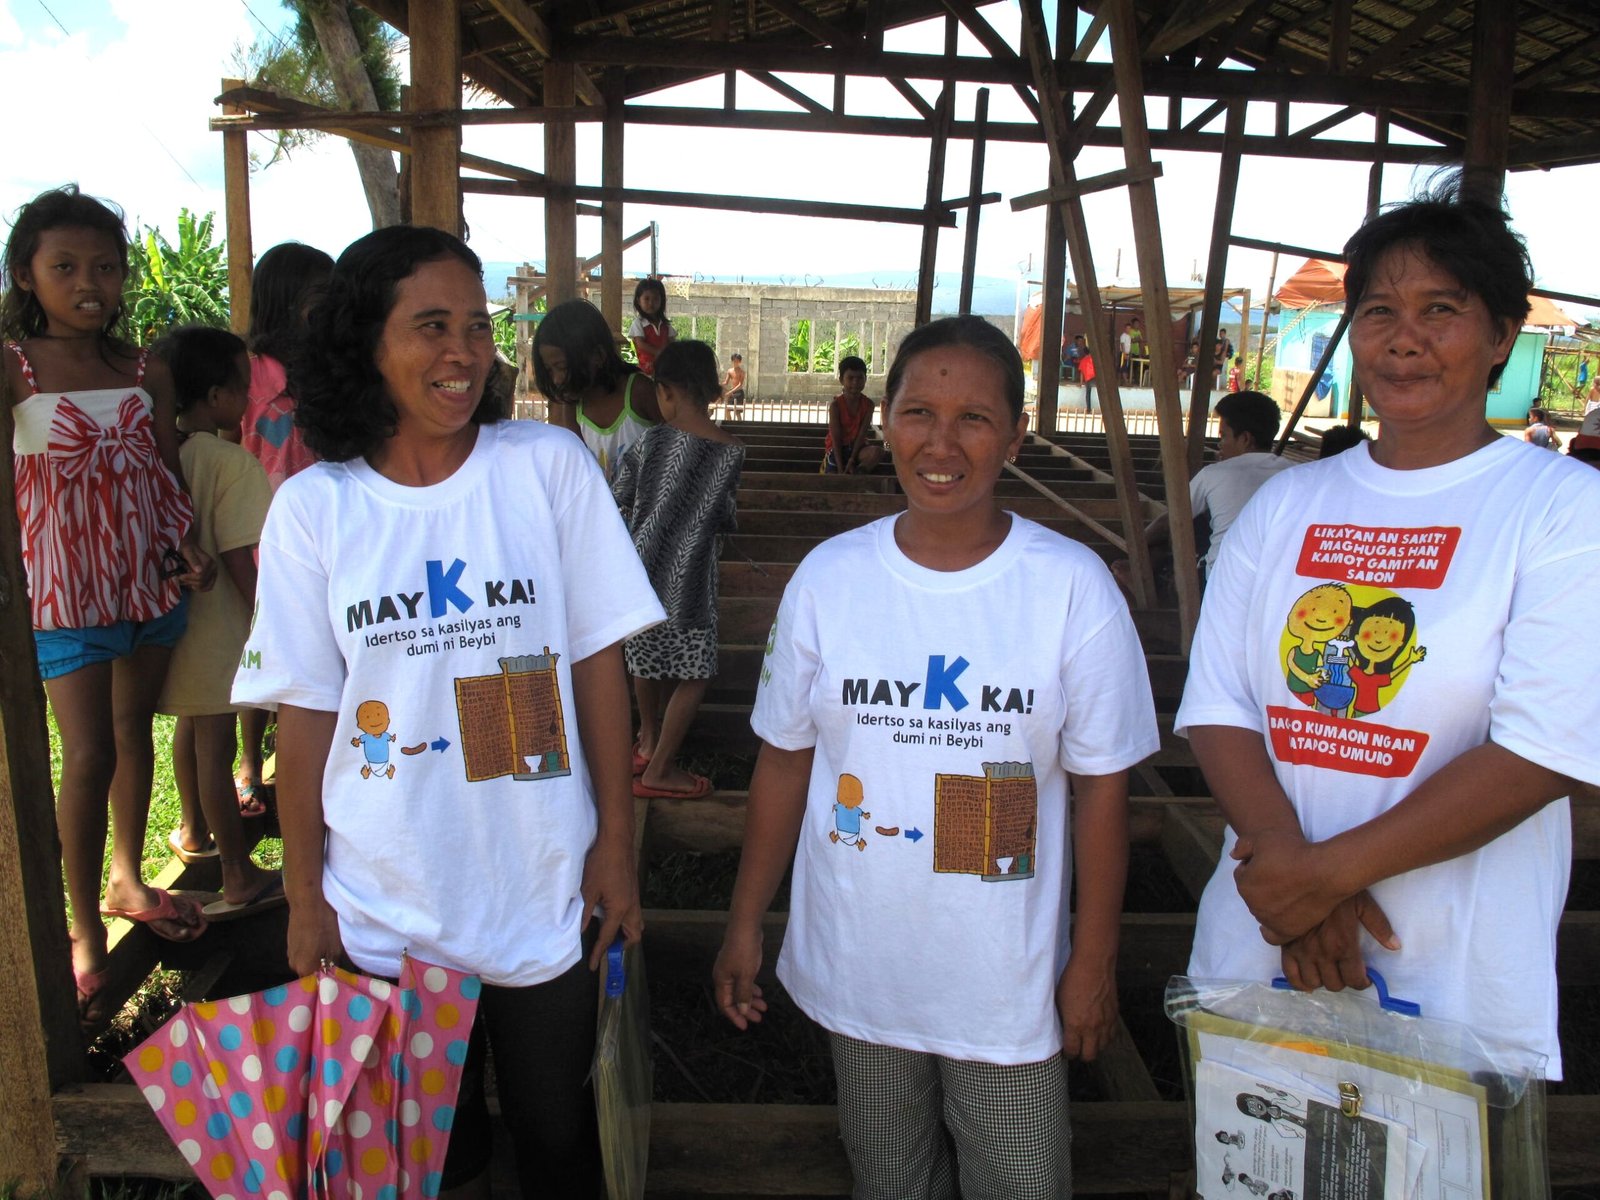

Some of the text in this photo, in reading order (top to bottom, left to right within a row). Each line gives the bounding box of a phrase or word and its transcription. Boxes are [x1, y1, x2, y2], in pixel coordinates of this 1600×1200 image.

[1314, 527, 1447, 545] LIKAYAN AN SAKIT!
[1319, 540, 1438, 557] MAGHUGAS HAN
[1311, 551, 1438, 571] KAMOT GAMIT AN
[1346, 569, 1395, 583] SABON
[346, 558, 536, 633] MAY K KA!
[365, 615, 521, 648] Idertso sa kasilyas ang
[406, 632, 496, 656] dumi ni Beybi
[842, 654, 1034, 714] MAY K KA!
[857, 713, 1011, 735] Idertso sa kasilyas ang
[893, 731, 983, 749] dumi ni Beybi
[1305, 720, 1368, 745] KUMAON
[1371, 733, 1415, 751] NGAN
